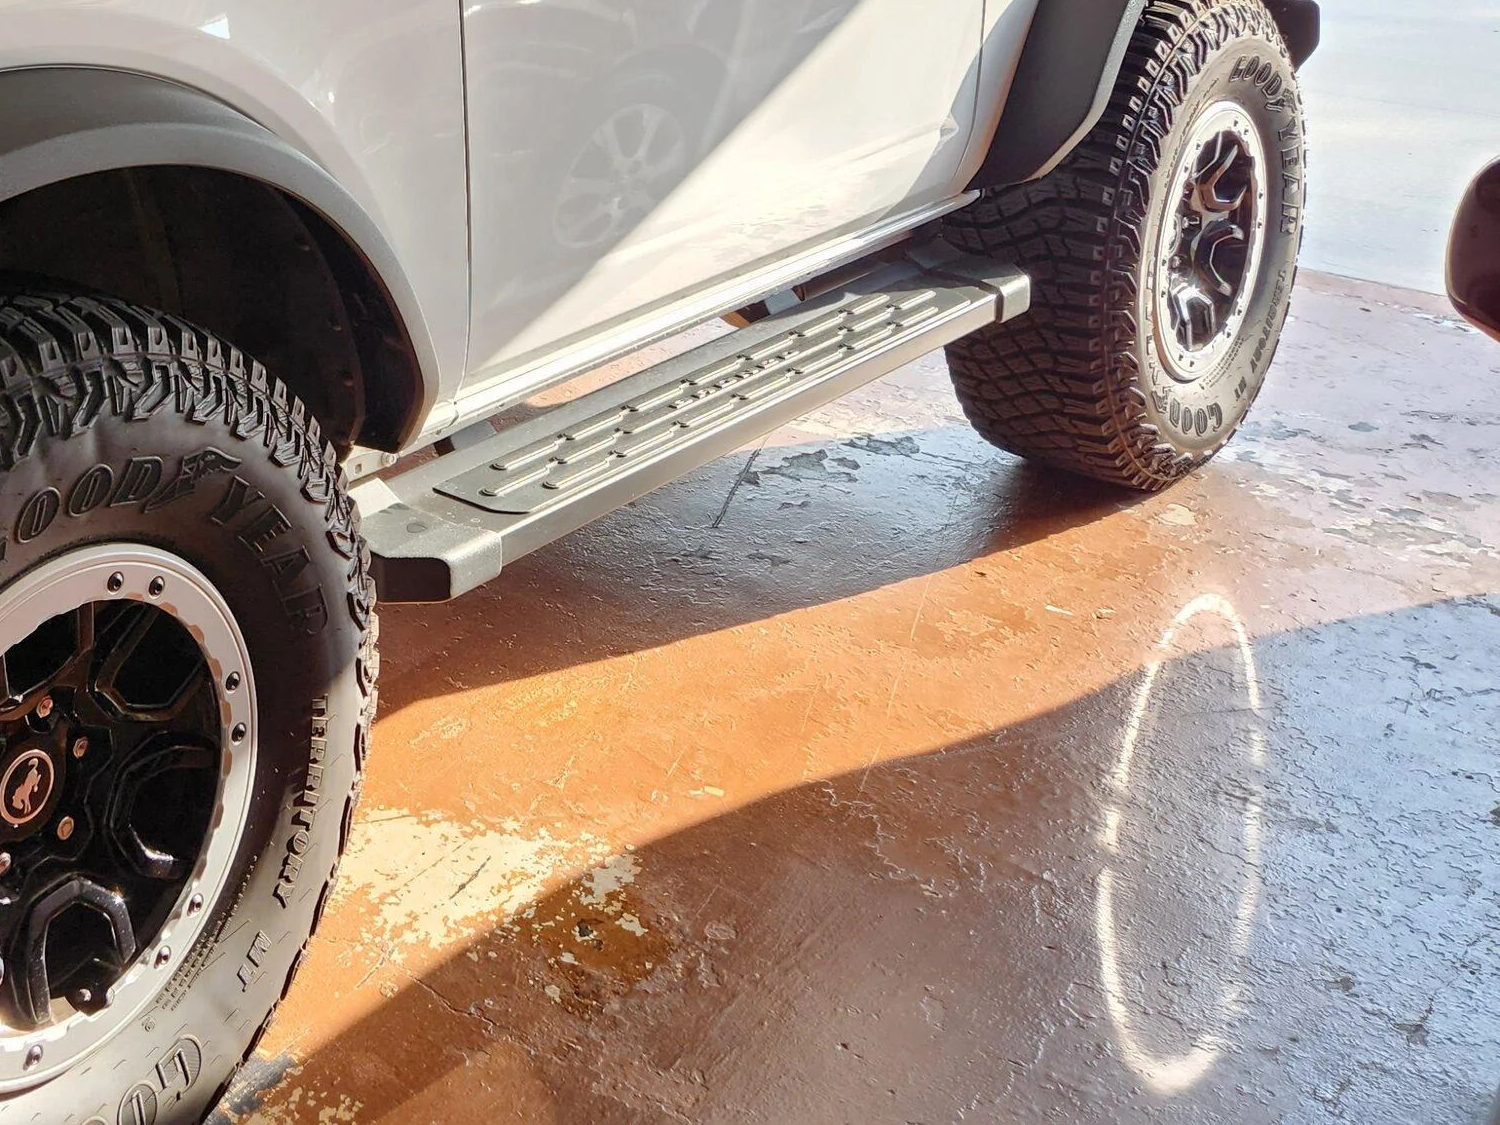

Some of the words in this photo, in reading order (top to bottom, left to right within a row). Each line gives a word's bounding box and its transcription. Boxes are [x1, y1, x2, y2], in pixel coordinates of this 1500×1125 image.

[1228, 54, 1300, 236] GOODYEAR
[1249, 268, 1287, 377] TERRITORY
[274, 693, 330, 910] TERRITORY
